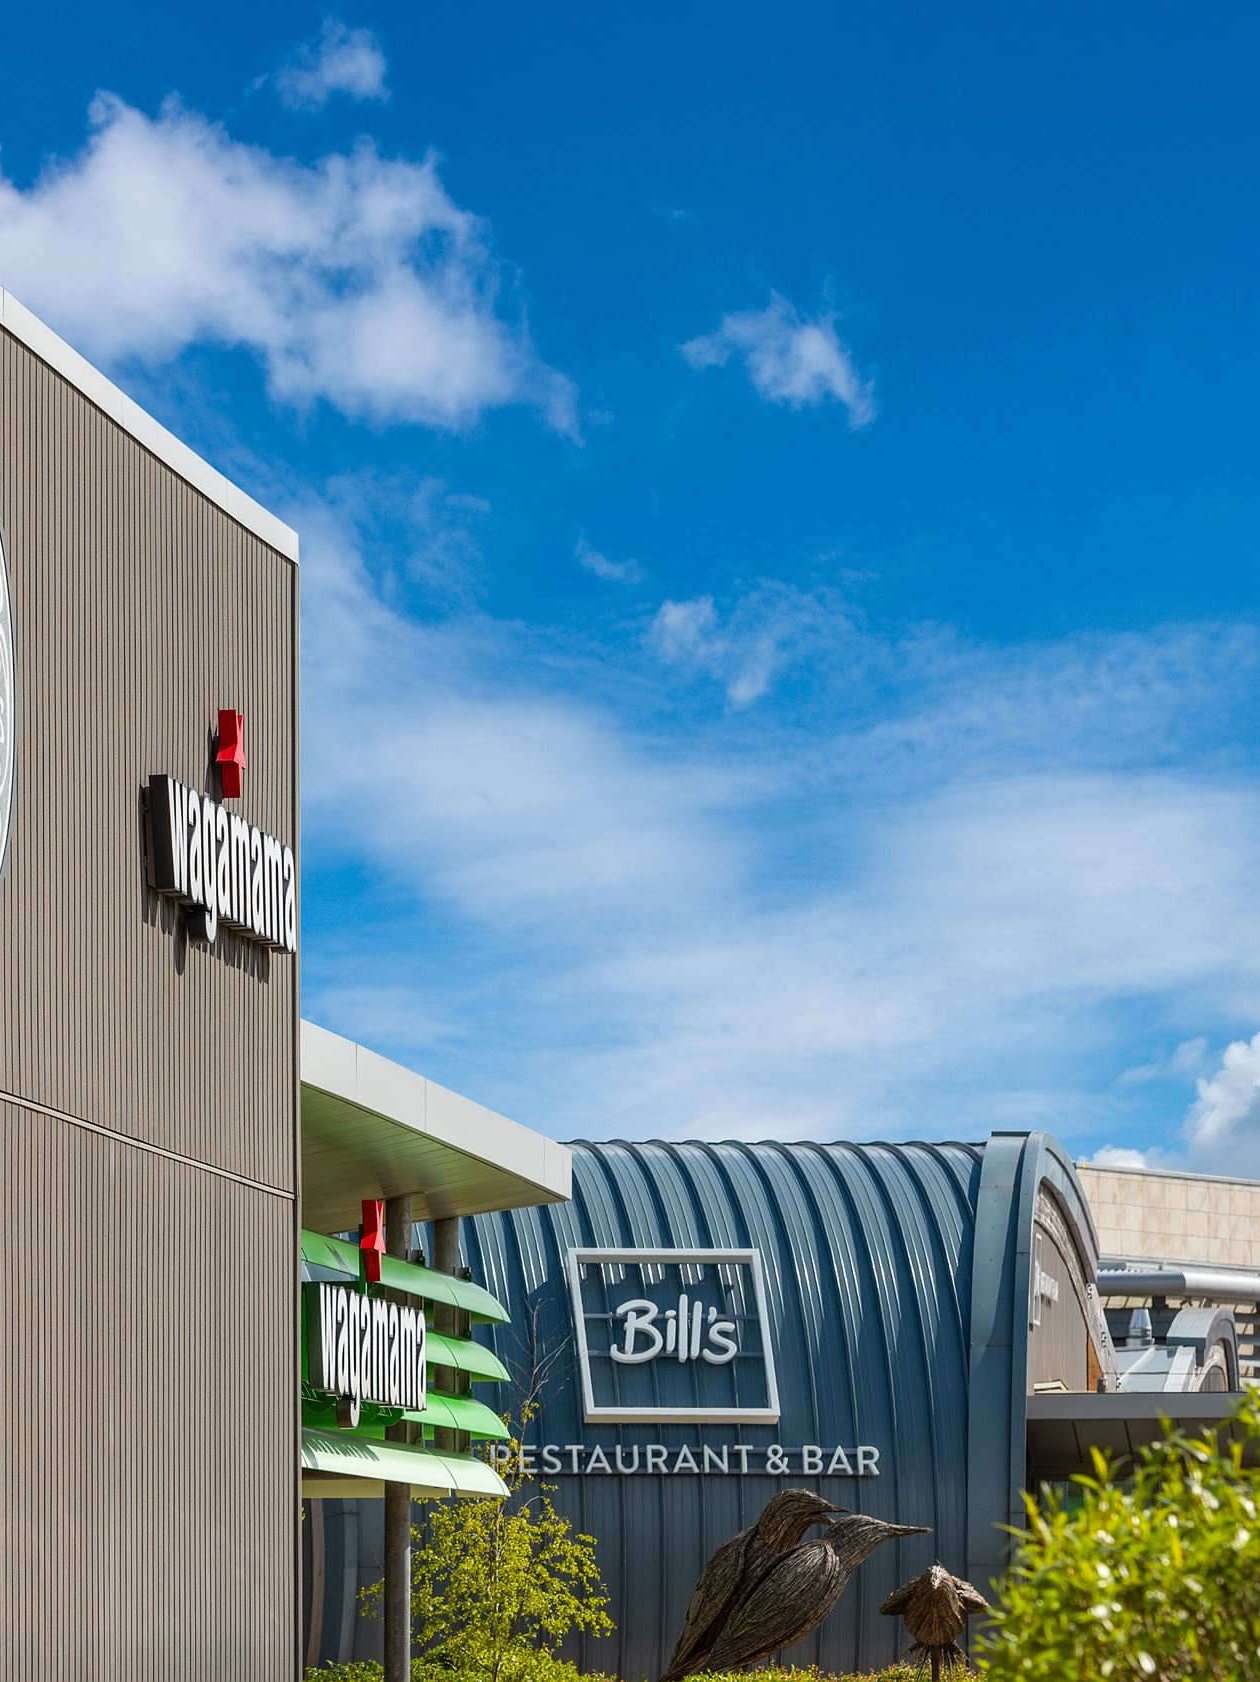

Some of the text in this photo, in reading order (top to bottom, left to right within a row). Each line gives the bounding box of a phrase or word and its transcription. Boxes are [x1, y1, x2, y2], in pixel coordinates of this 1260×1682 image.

[168, 775, 297, 954] wagamama
[319, 1282, 427, 1429] wagamama
[609, 1293, 739, 1365] Bill's
[765, 1444, 791, 1476] &
[802, 1445, 881, 1477] BAR
